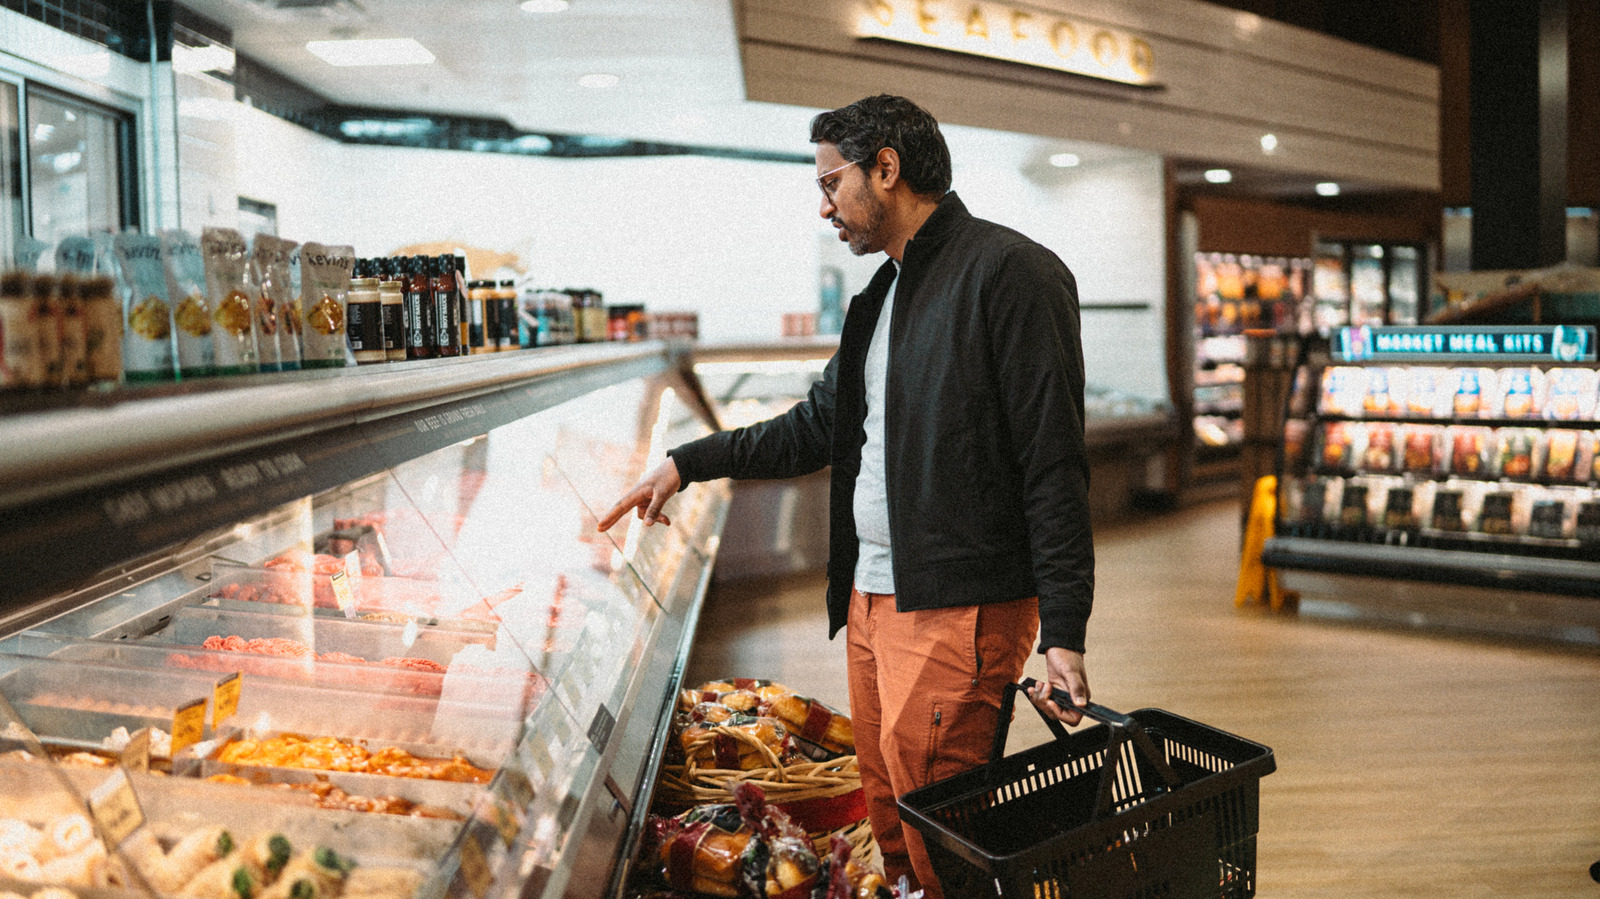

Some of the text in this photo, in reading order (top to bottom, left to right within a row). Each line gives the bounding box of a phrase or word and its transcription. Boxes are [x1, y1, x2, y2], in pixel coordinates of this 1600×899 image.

[868, 0, 1154, 77] SEAFOOD
[1376, 333, 1544, 352] MARKET MEAL KITS
